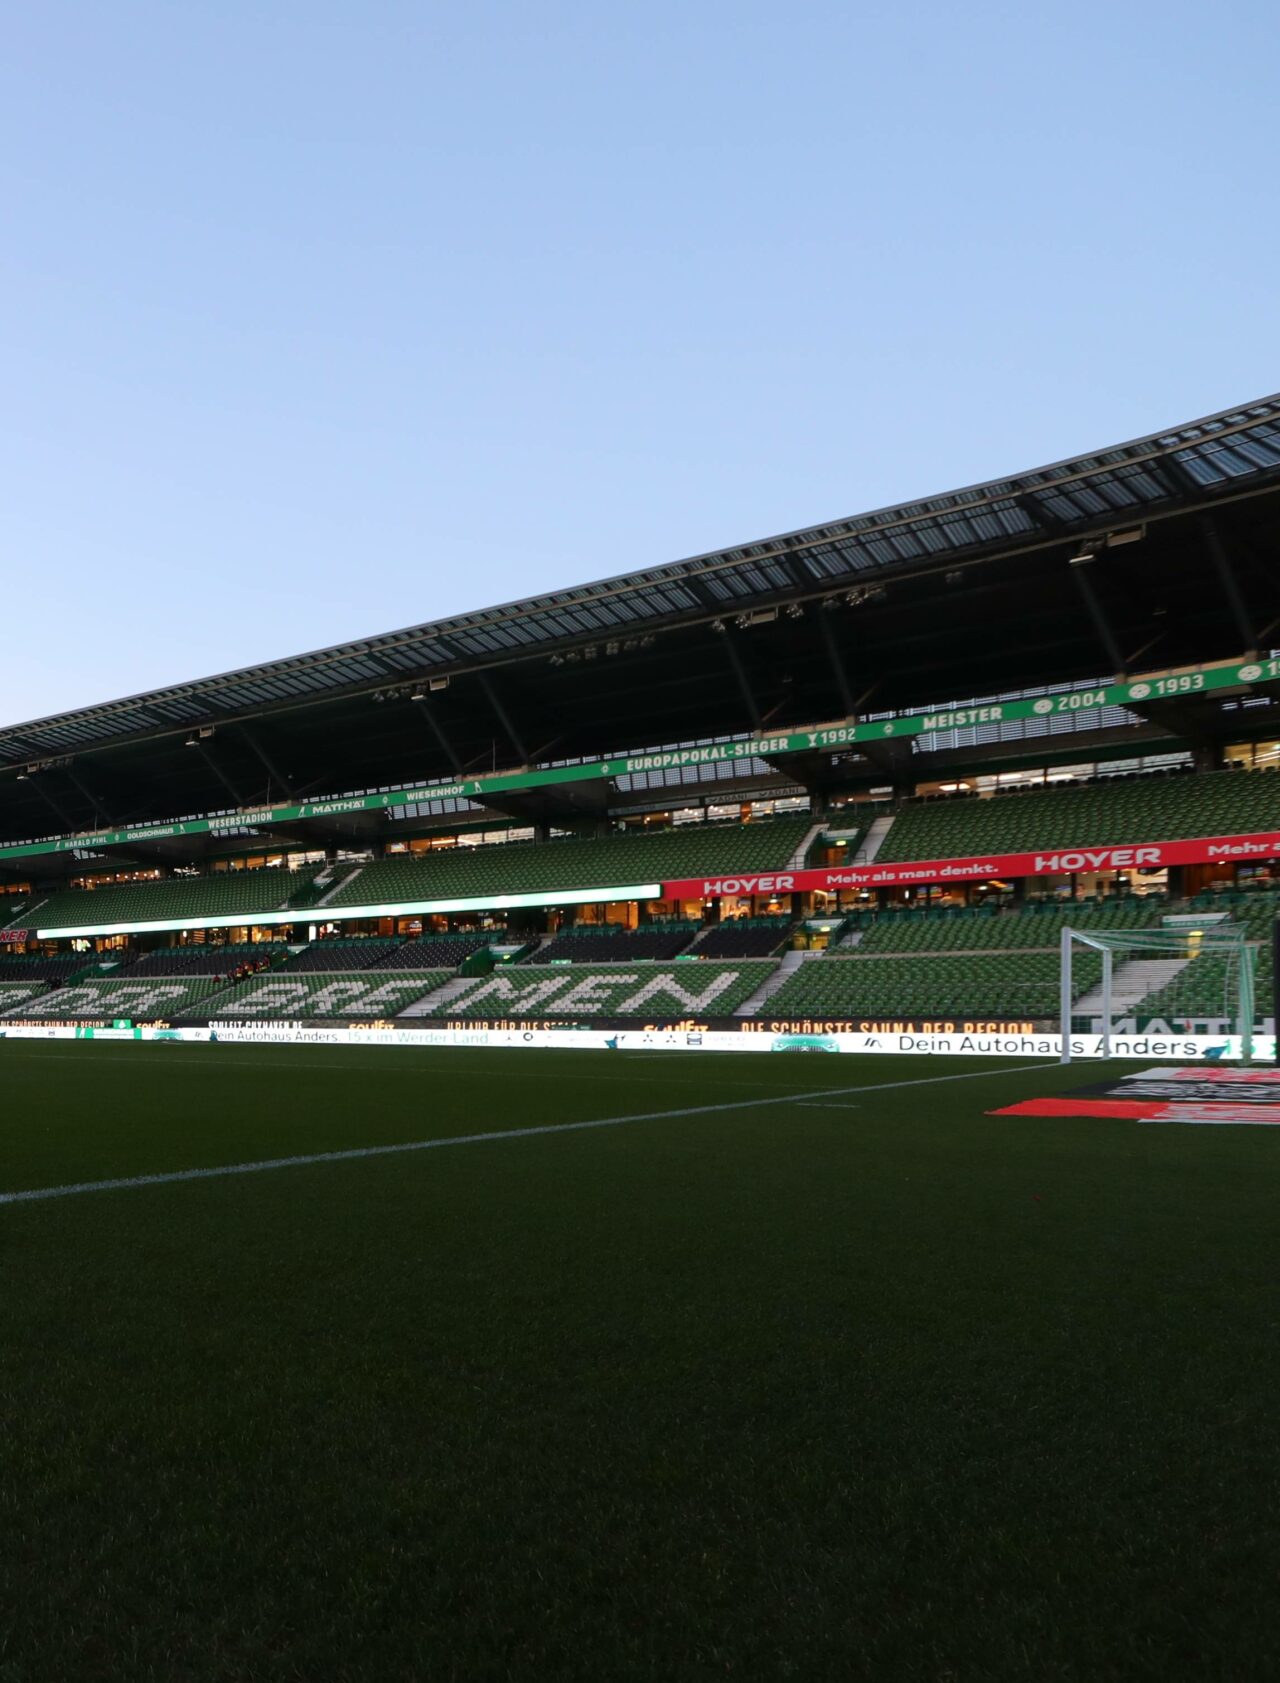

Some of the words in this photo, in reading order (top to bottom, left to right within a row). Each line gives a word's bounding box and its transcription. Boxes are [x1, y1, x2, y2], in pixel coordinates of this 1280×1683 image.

[923, 708, 1003, 730] MEISTER
[1058, 691, 1106, 711] 2004
[1155, 673, 1204, 694] 1993
[626, 738, 789, 771] EUROPAPOKAL-SIEGER
[820, 728, 856, 744] 1992
[406, 785, 465, 801] WIESENHOF
[767, 788, 799, 798] ADANI
[207, 812, 272, 830] WESERSTADION
[64, 838, 90, 848] HARALD
[91, 836, 107, 845] PIHL
[126, 827, 174, 840] GOLDSCHMAUS
[1208, 842, 1269, 856] Mehr
[1034, 847, 1161, 872] HOYER
[827, 873, 870, 885] Mehr
[872, 871, 896, 882] als
[899, 868, 937, 880] man
[939, 863, 1000, 877] denkt.
[703, 875, 795, 895] HOYER
[216, 972, 741, 1014] BREMEN
[742, 1022, 764, 1032] DIE
[771, 1020, 852, 1033] SCHÖNSTE
[860, 1022, 918, 1034] SAUNA
[923, 1022, 955, 1034] DER
[963, 1022, 1034, 1034] REGION
[237, 1030, 292, 1041] Autohaus
[295, 1030, 341, 1042] Anders.
[396, 1032, 448, 1044] Werder
[899, 1035, 951, 1052] Dein
[959, 1036, 1085, 1054] Autohaus
